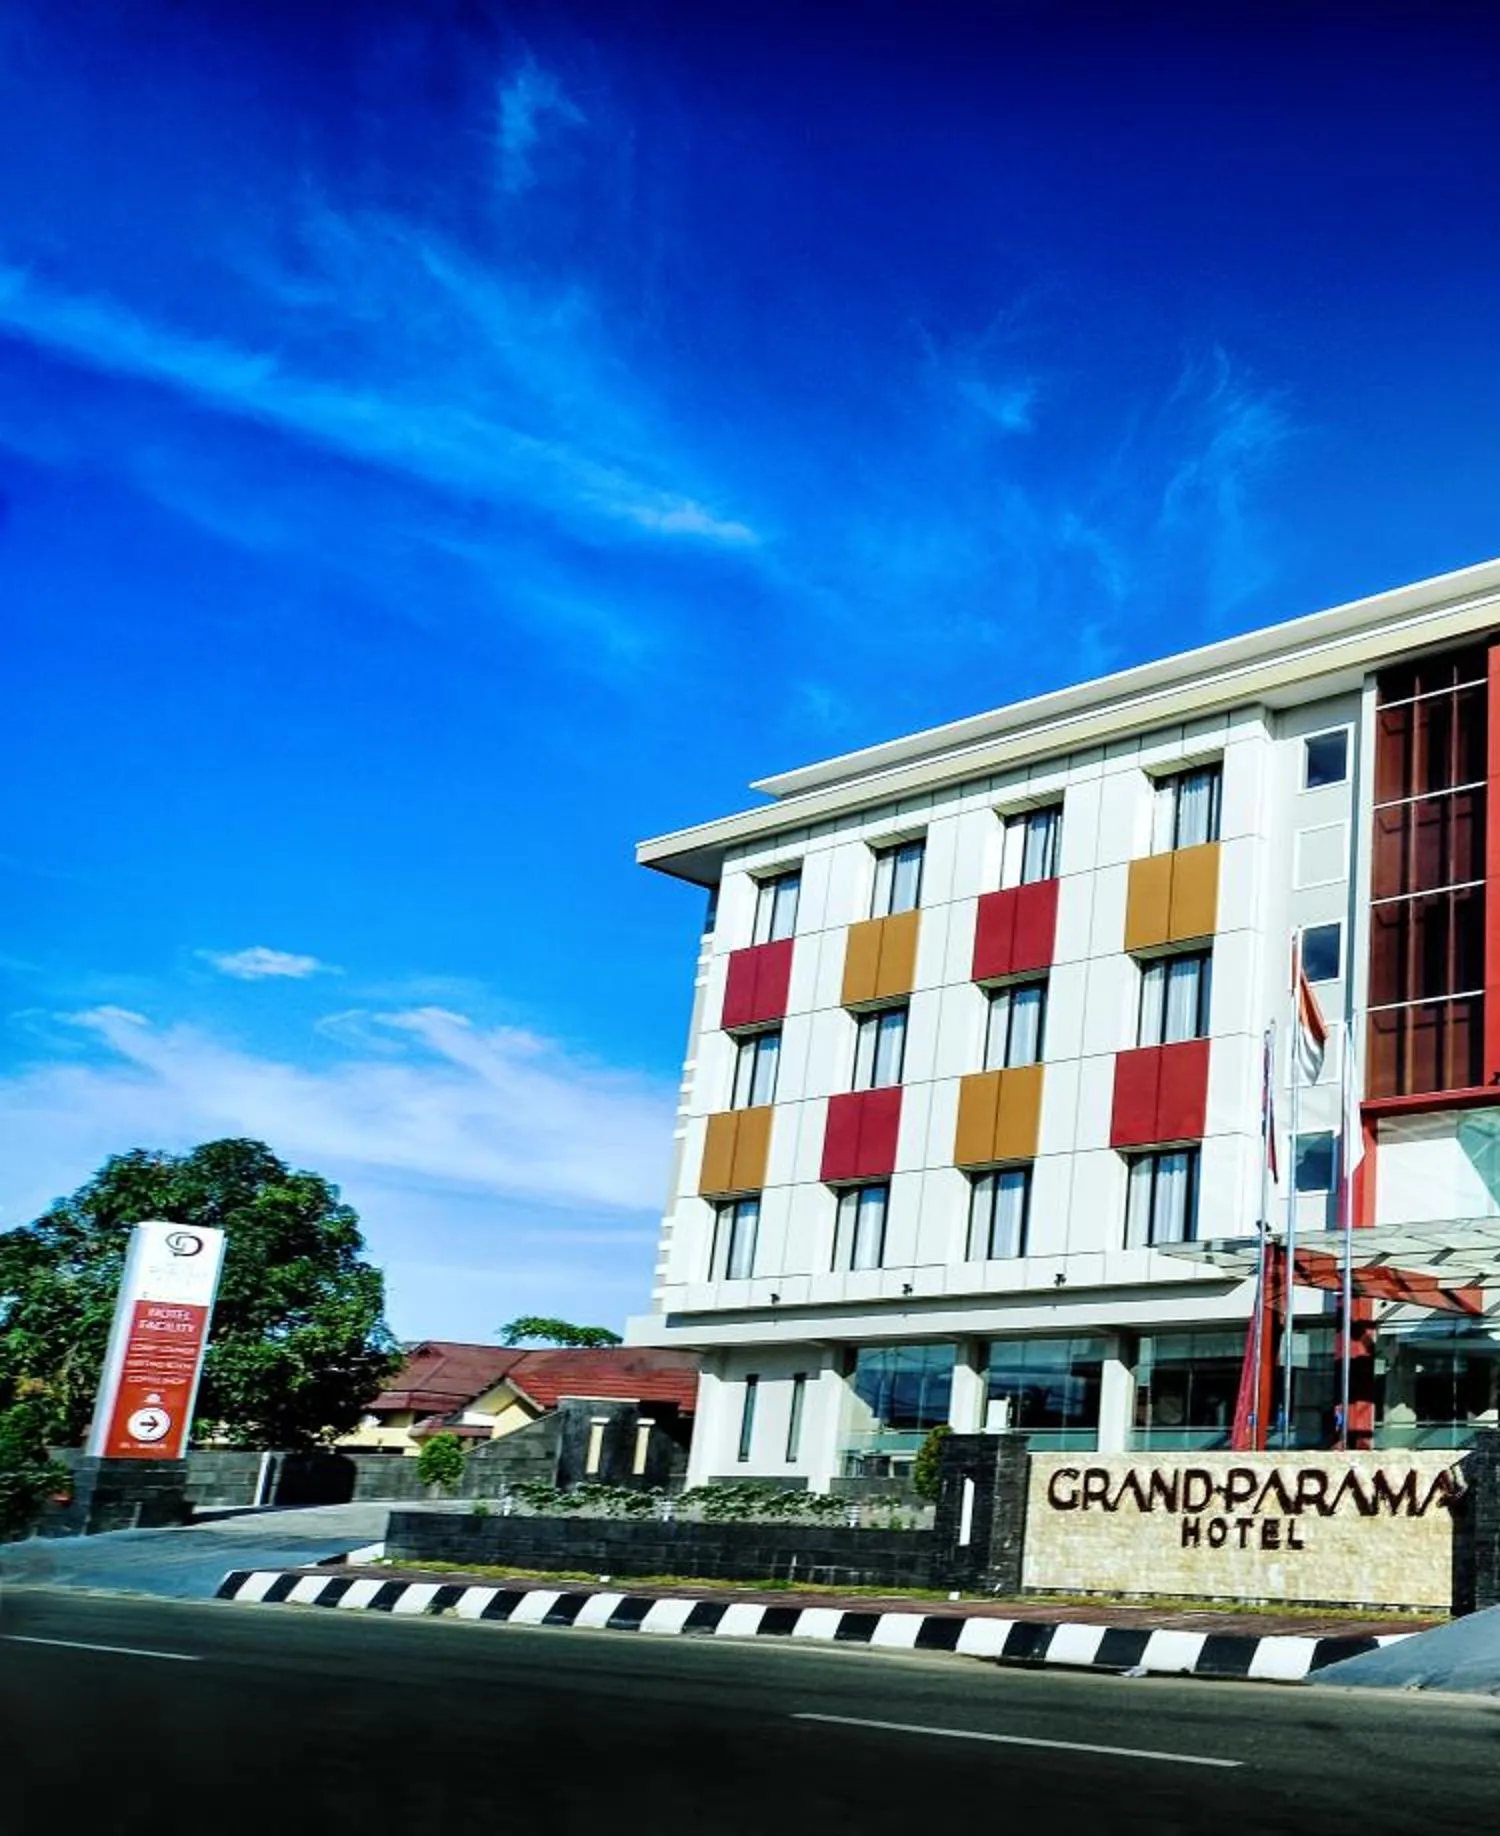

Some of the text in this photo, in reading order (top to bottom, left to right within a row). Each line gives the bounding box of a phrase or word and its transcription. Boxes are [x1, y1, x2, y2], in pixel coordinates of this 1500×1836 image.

[147, 1307, 192, 1321] HOTEL
[138, 1320, 196, 1333] FACILITY
[1181, 1516, 1303, 1550] HOTEL
